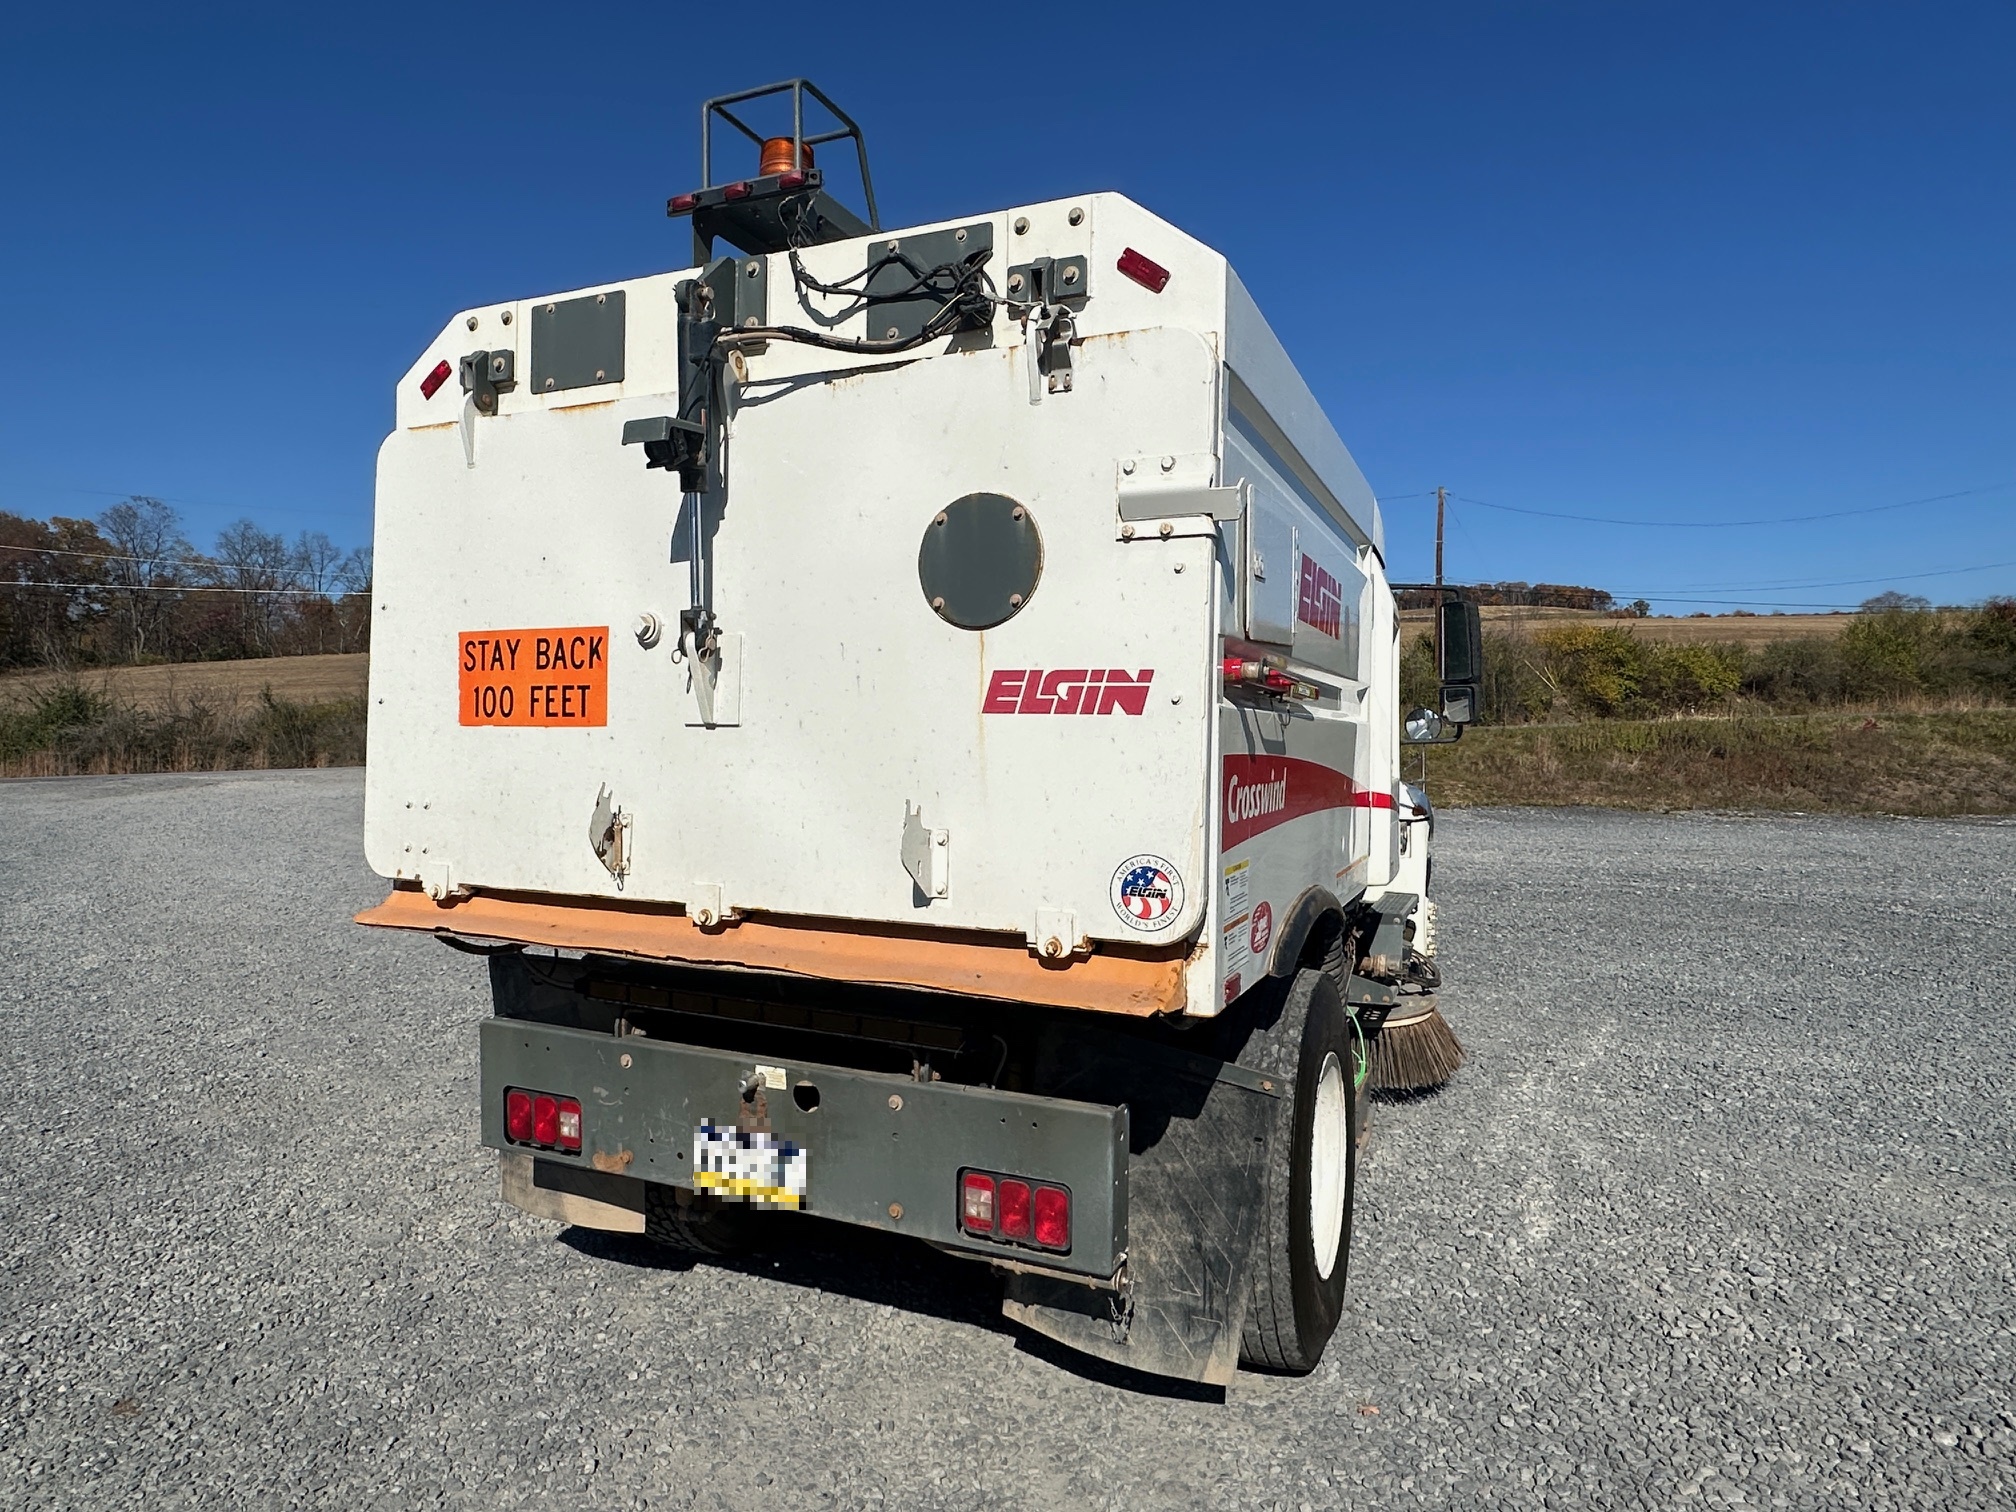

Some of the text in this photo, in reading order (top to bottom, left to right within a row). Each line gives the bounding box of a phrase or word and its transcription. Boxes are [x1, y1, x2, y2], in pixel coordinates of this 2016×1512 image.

[1298, 552, 1342, 640] ELGIN
[464, 636, 603, 671] STAY BACK
[474, 685, 591, 718] 100 FEET
[982, 669, 1155, 715] ELGIN
[1228, 767, 1287, 823] Crosswind
[1117, 859, 1180, 886] AMERICA'S FIRST
[1129, 886, 1167, 899] ELGIN
[1116, 902, 1178, 928] WORLD'S FINEST
